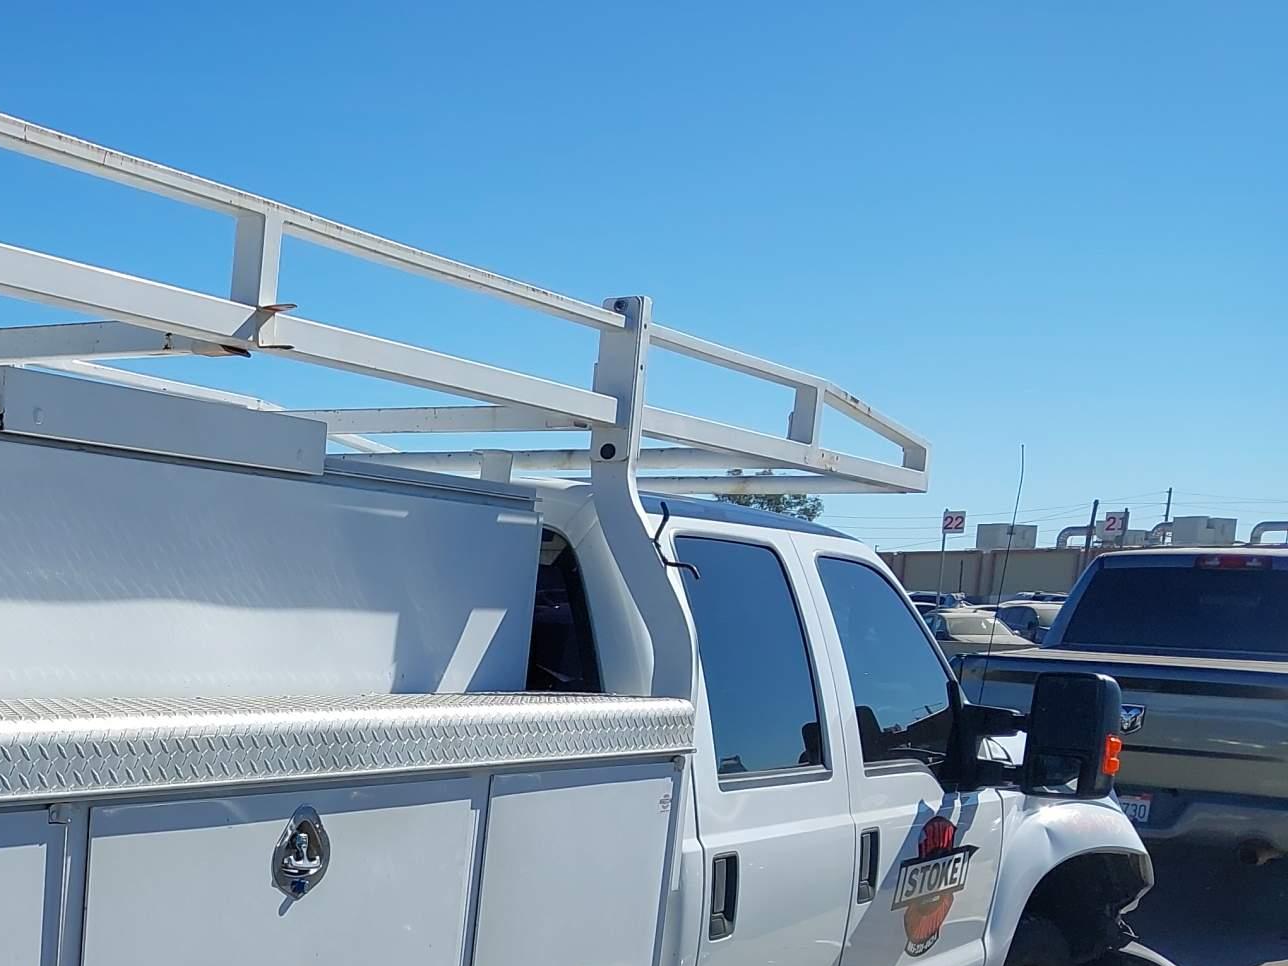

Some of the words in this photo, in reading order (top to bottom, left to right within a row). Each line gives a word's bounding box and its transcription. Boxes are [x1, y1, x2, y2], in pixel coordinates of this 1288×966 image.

[943, 516, 964, 530] 22
[1105, 517, 1126, 532] 21
[904, 857, 961, 898] STOKE
